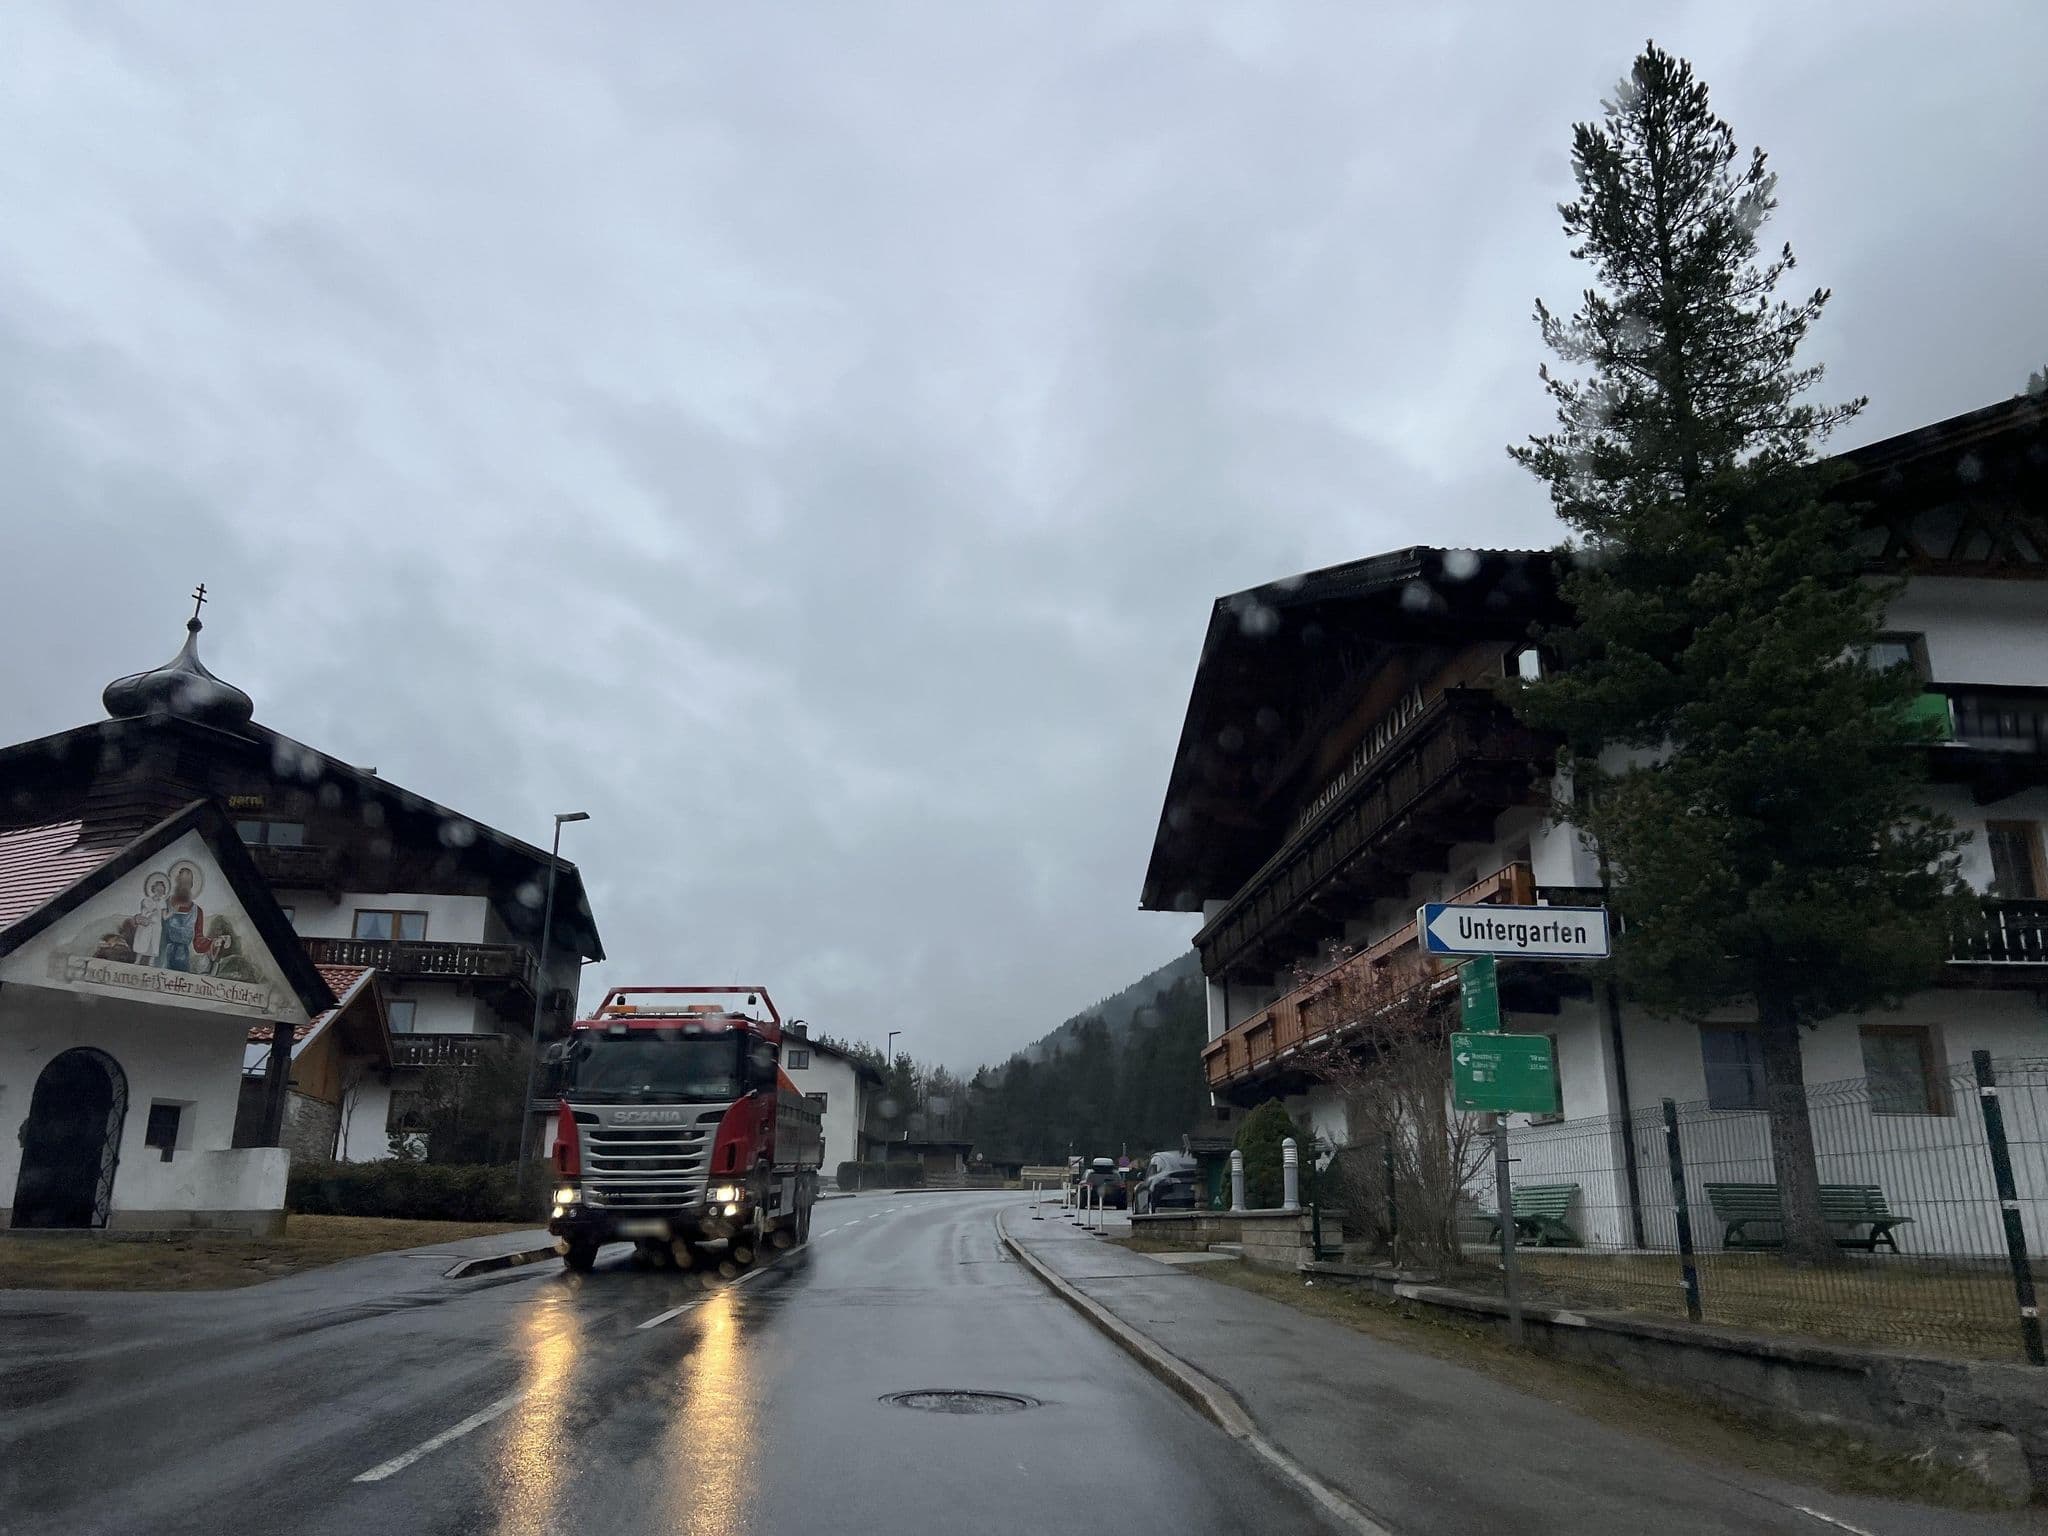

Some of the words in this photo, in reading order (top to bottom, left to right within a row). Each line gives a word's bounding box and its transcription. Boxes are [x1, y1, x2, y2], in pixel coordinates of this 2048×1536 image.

[1353, 683, 1425, 775] EUROPA
[1459, 916, 1586, 947] Untergarten
[614, 1111, 681, 1122] SCANIA
